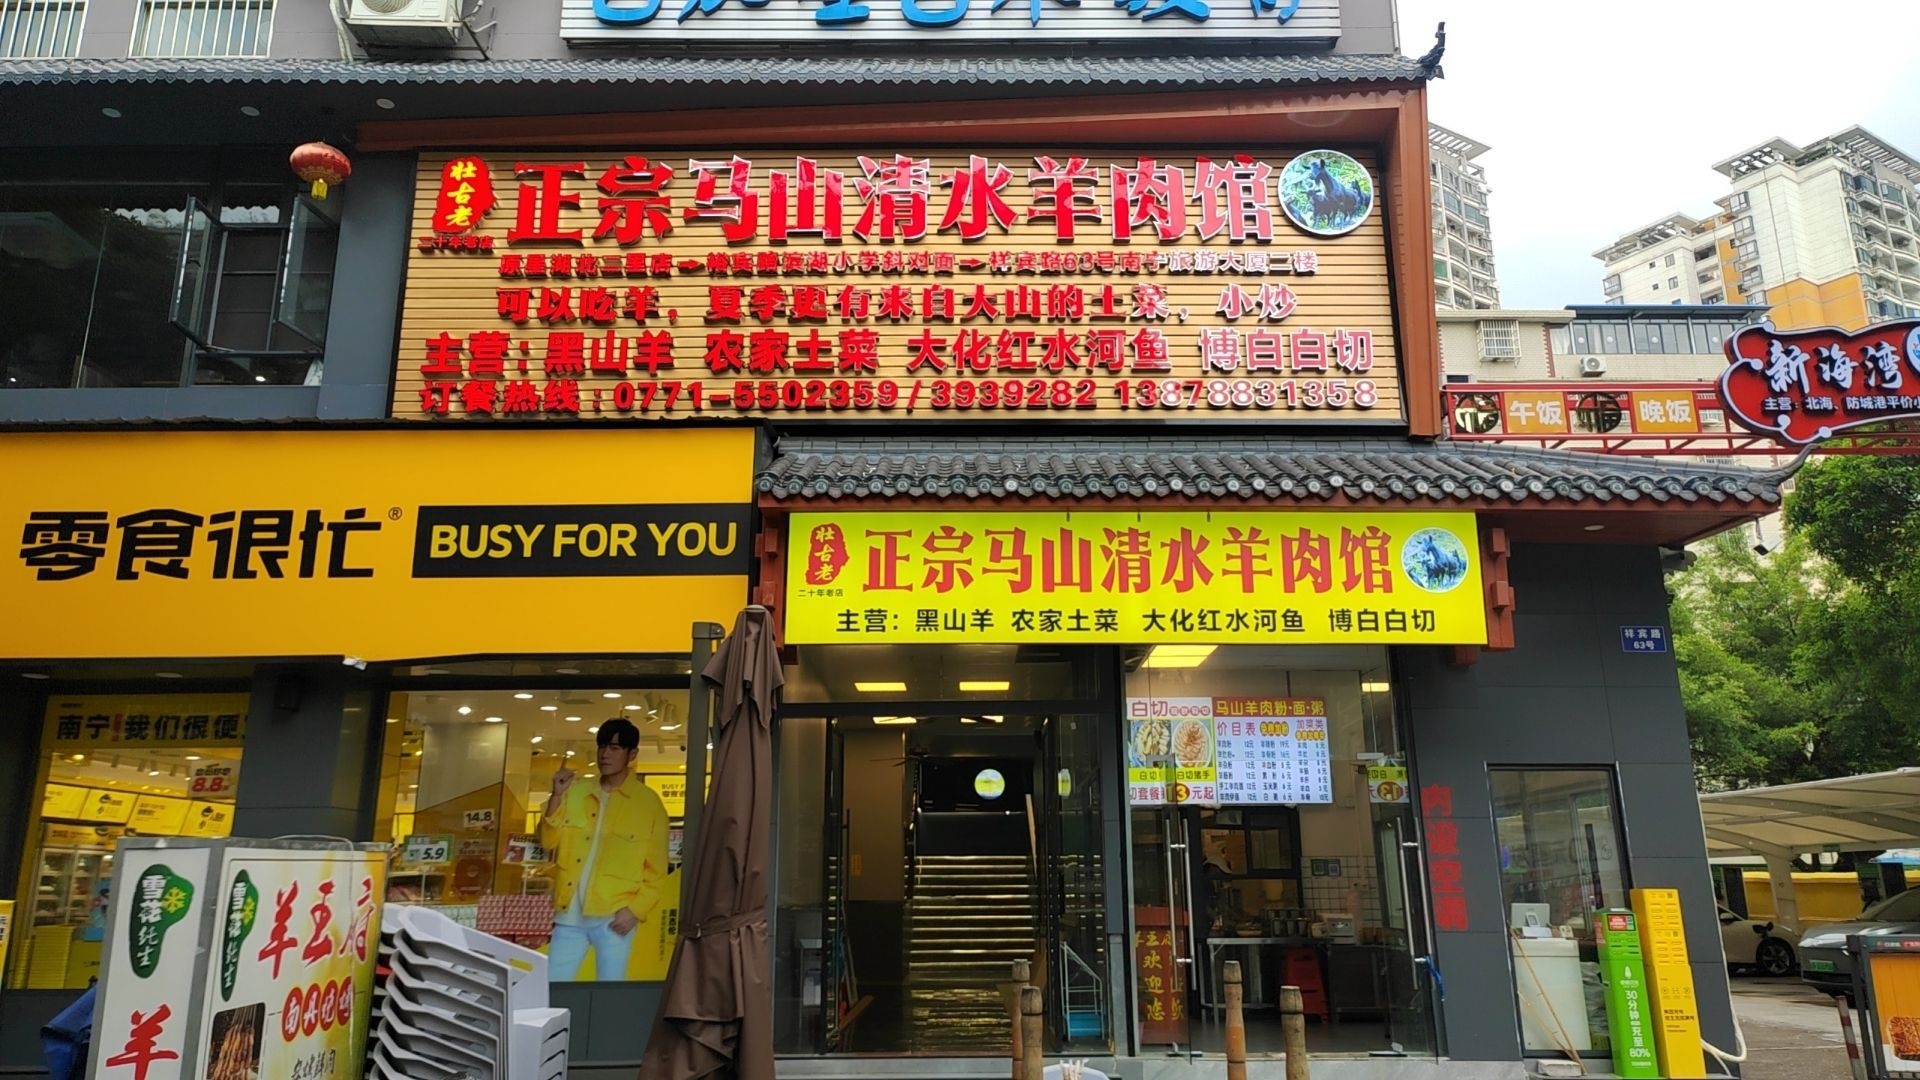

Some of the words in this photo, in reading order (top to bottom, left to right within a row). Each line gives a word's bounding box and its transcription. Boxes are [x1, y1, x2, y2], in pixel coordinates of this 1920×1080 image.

[445, 161, 478, 226] 壮古老
[506, 154, 1274, 247] 正宗马山清水羊肉馆
[1216, 282, 1299, 321] 小炒
[703, 329, 880, 374] 农家土菜
[905, 328, 1173, 374] 大化红水河鱼
[1198, 328, 1375, 374] 博白白切
[1766, 339, 1904, 395] 新海湾
[1112, 379, 1379, 410] 13878831358
[1509, 401, 1563, 427] 午饭
[1640, 400, 1693, 425] 晚饭
[20, 508, 383, 582] 零食很忙
[429, 523, 546, 559] BUSY
[552, 523, 638, 558] FOR
[647, 521, 737, 557] YOU
[814, 525, 836, 582] 壮古老
[862, 525, 1395, 595] 正宗马山清水羊肉馆
[797, 588, 844, 598] 二十年老店
[1010, 609, 1119, 633] 农家土菜
[1142, 608, 1306, 634] 大化红水河鱼
[1328, 608, 1436, 634] 博白白切
[1624, 628, 1662, 639] 祥宾路
[1633, 640, 1655, 650] 63号
[1217, 721, 1256, 737] 价目表
[465, 811, 493, 824] 14.8
[421, 847, 445, 860] 5.9
[105, 1003, 179, 1080] 羊
